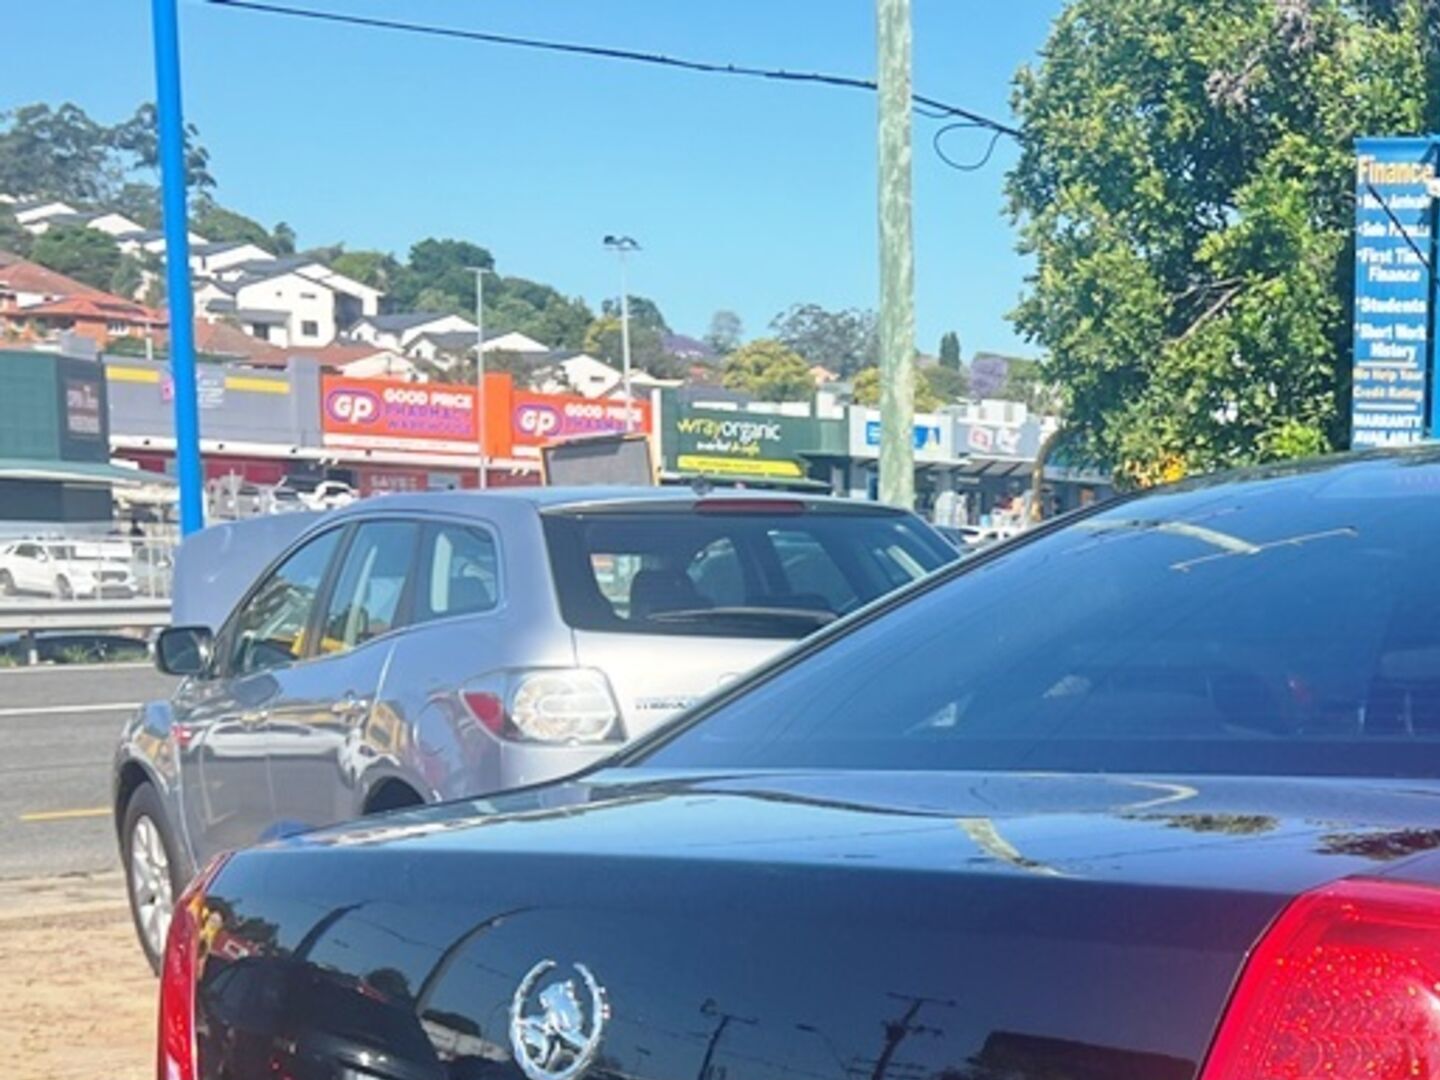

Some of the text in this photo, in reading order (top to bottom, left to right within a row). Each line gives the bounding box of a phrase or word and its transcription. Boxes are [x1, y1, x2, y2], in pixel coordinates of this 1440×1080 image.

[1358, 154, 1434, 184] Finance
[1368, 266, 1420, 282] Finance
[1361, 296, 1427, 313] Students
[383, 388, 472, 409] GOOD PRICE
[564, 404, 604, 417] GOOD
